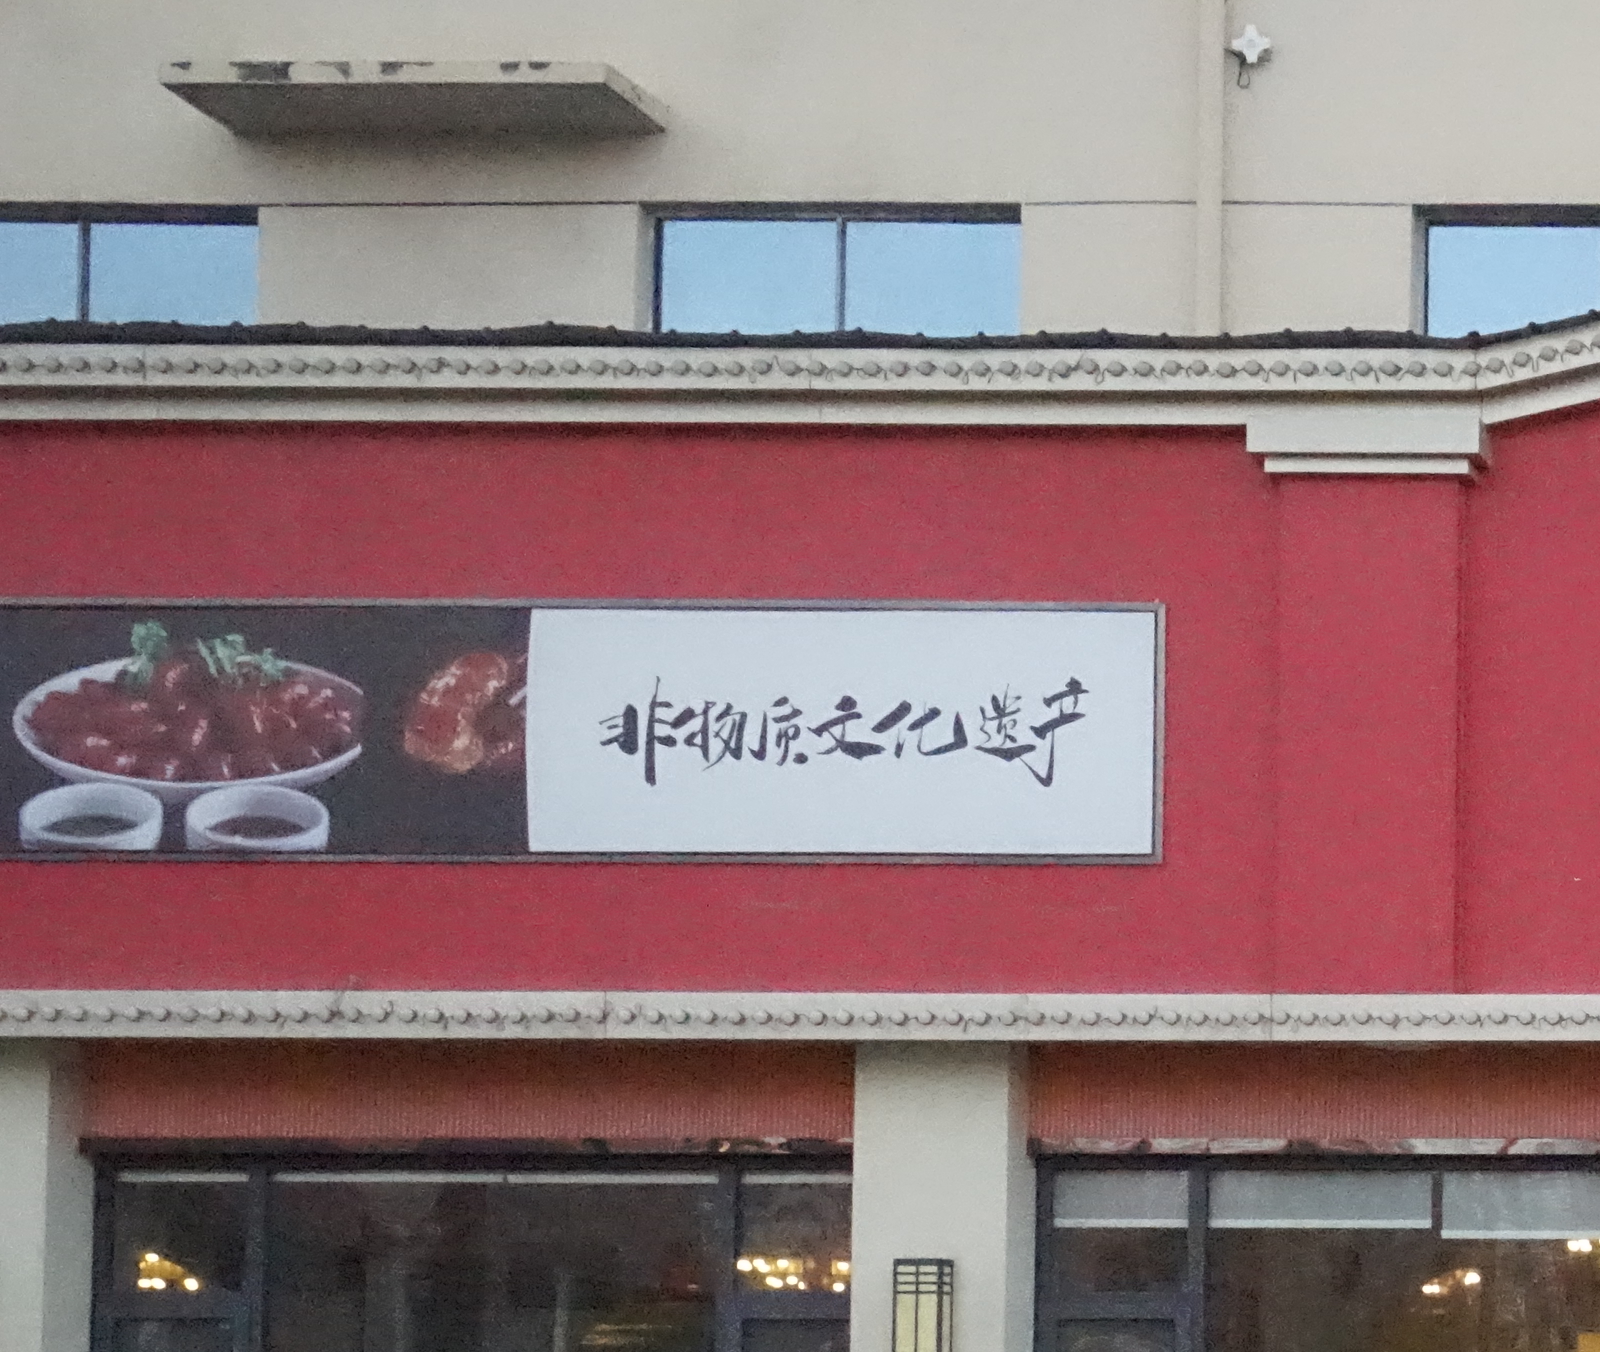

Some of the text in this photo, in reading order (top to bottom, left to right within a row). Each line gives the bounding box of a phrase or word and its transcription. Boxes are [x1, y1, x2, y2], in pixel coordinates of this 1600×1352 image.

[598, 676, 1090, 787] 非物质文化遗产
